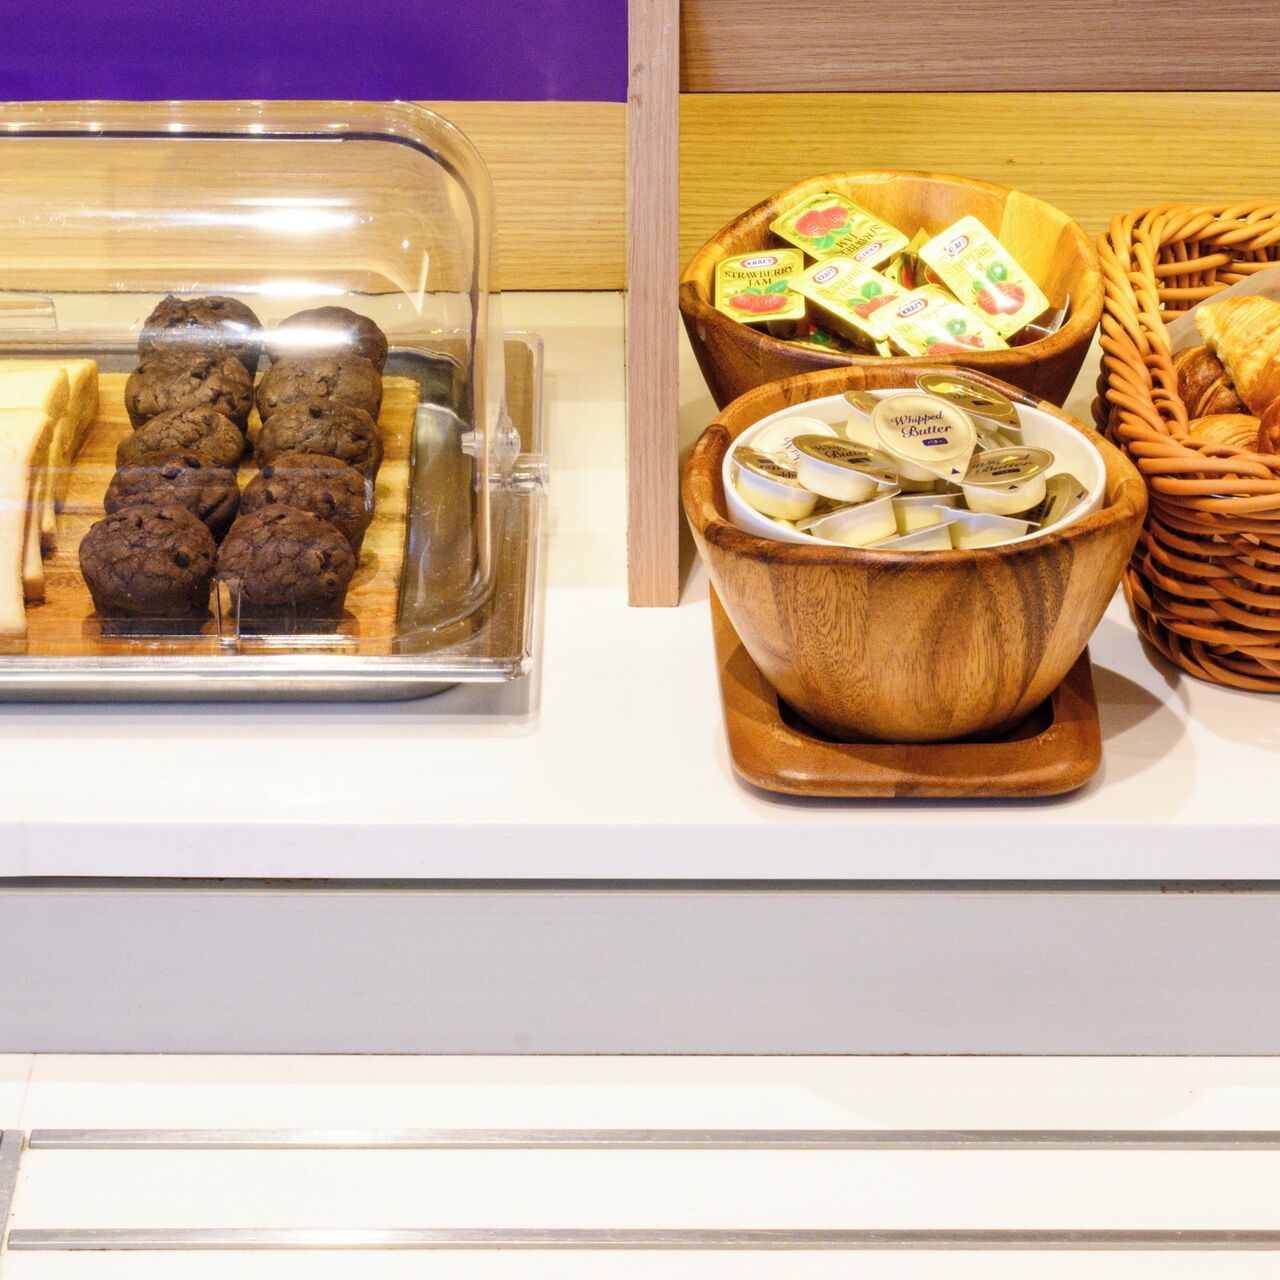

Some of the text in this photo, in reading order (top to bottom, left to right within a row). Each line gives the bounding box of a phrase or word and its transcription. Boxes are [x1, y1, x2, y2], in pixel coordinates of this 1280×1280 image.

[745, 258, 773, 266] KRAFT
[724, 265, 794, 279] STRAWBERRY
[747, 278, 772, 287] JAM
[890, 410, 945, 426] Whipped
[901, 424, 953, 438] Butter
